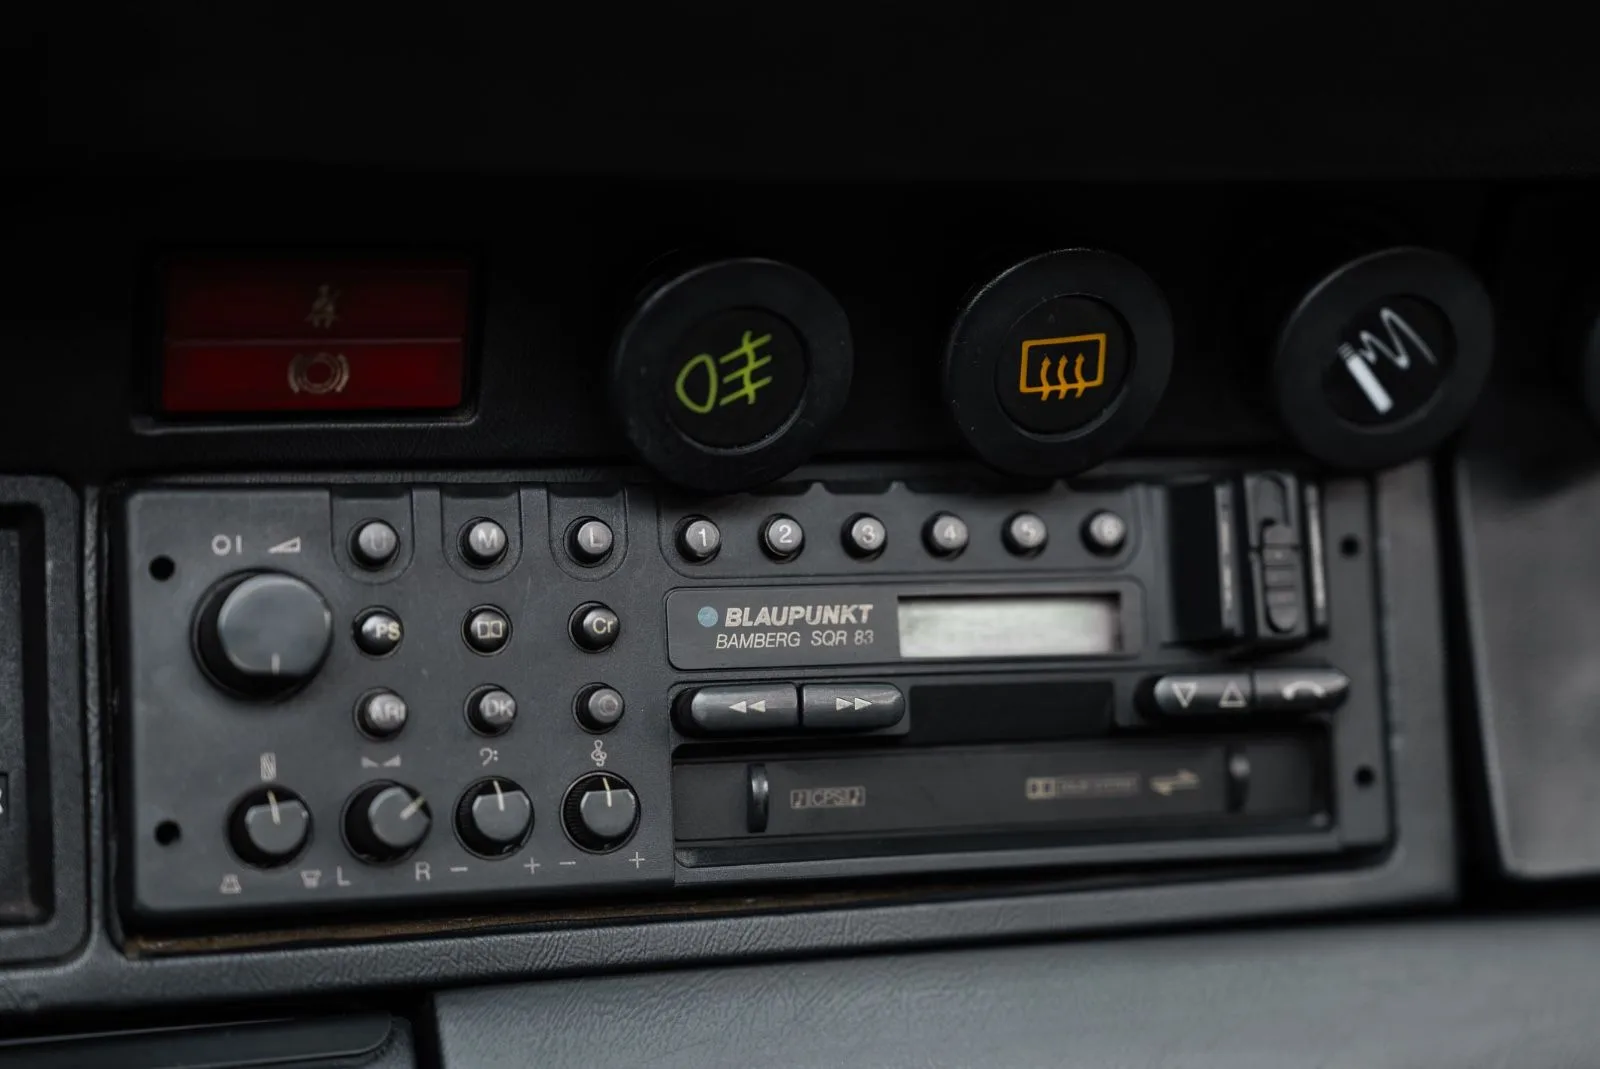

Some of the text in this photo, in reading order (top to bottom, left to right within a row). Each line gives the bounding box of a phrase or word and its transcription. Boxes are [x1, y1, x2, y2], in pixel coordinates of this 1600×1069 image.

[479, 528, 497, 548] M
[589, 527, 604, 548] L
[697, 527, 707, 548] 1
[778, 525, 792, 543] 2
[862, 524, 876, 541] 3
[943, 524, 956, 541] 4
[1021, 521, 1036, 539] 5
[724, 604, 873, 627] BLAUPUNKT
[376, 623, 400, 641] PS
[593, 617, 612, 635] Cr
[715, 630, 874, 649] BAMBERG SQR 83
[484, 698, 513, 717] DK
[336, 867, 350, 887] L
[414, 862, 431, 881] R
